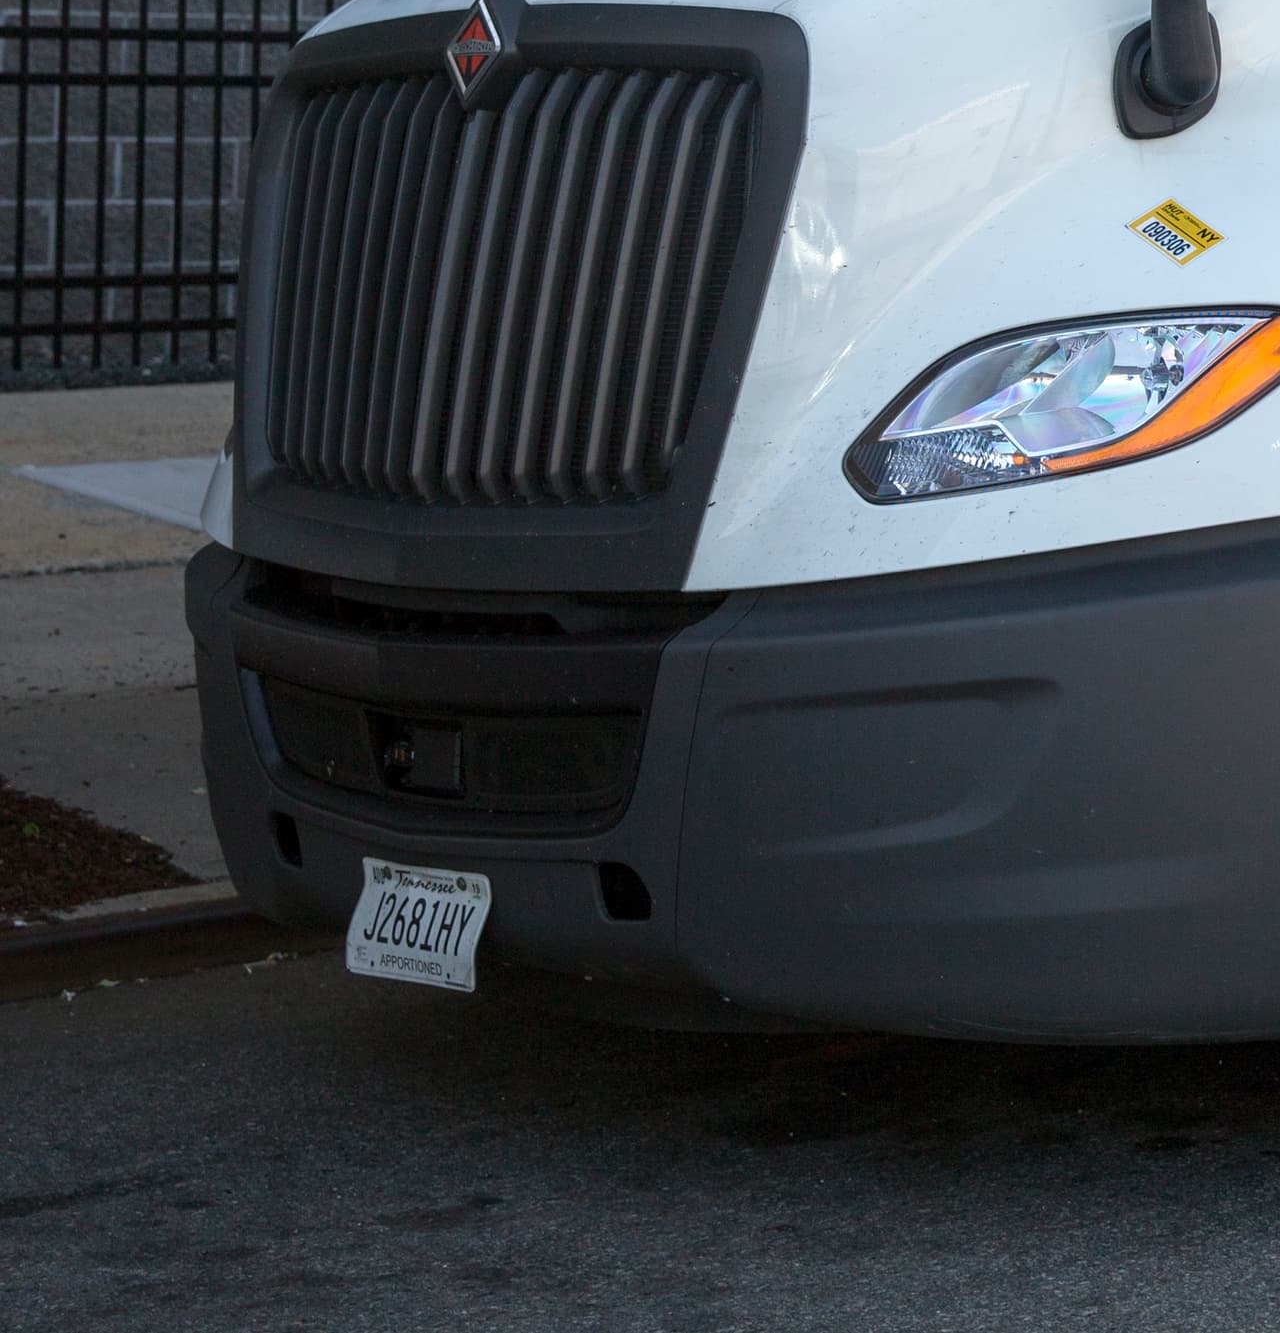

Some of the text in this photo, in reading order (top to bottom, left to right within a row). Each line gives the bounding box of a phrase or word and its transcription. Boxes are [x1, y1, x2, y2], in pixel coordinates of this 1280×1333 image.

[1142, 221, 1191, 256] 090306
[1165, 203, 1184, 215] HUT
[1196, 228, 1220, 243] NY
[395, 869, 458, 894] Tennessee
[364, 891, 476, 957] J2681HY
[380, 954, 442, 976] APPORTIONED
